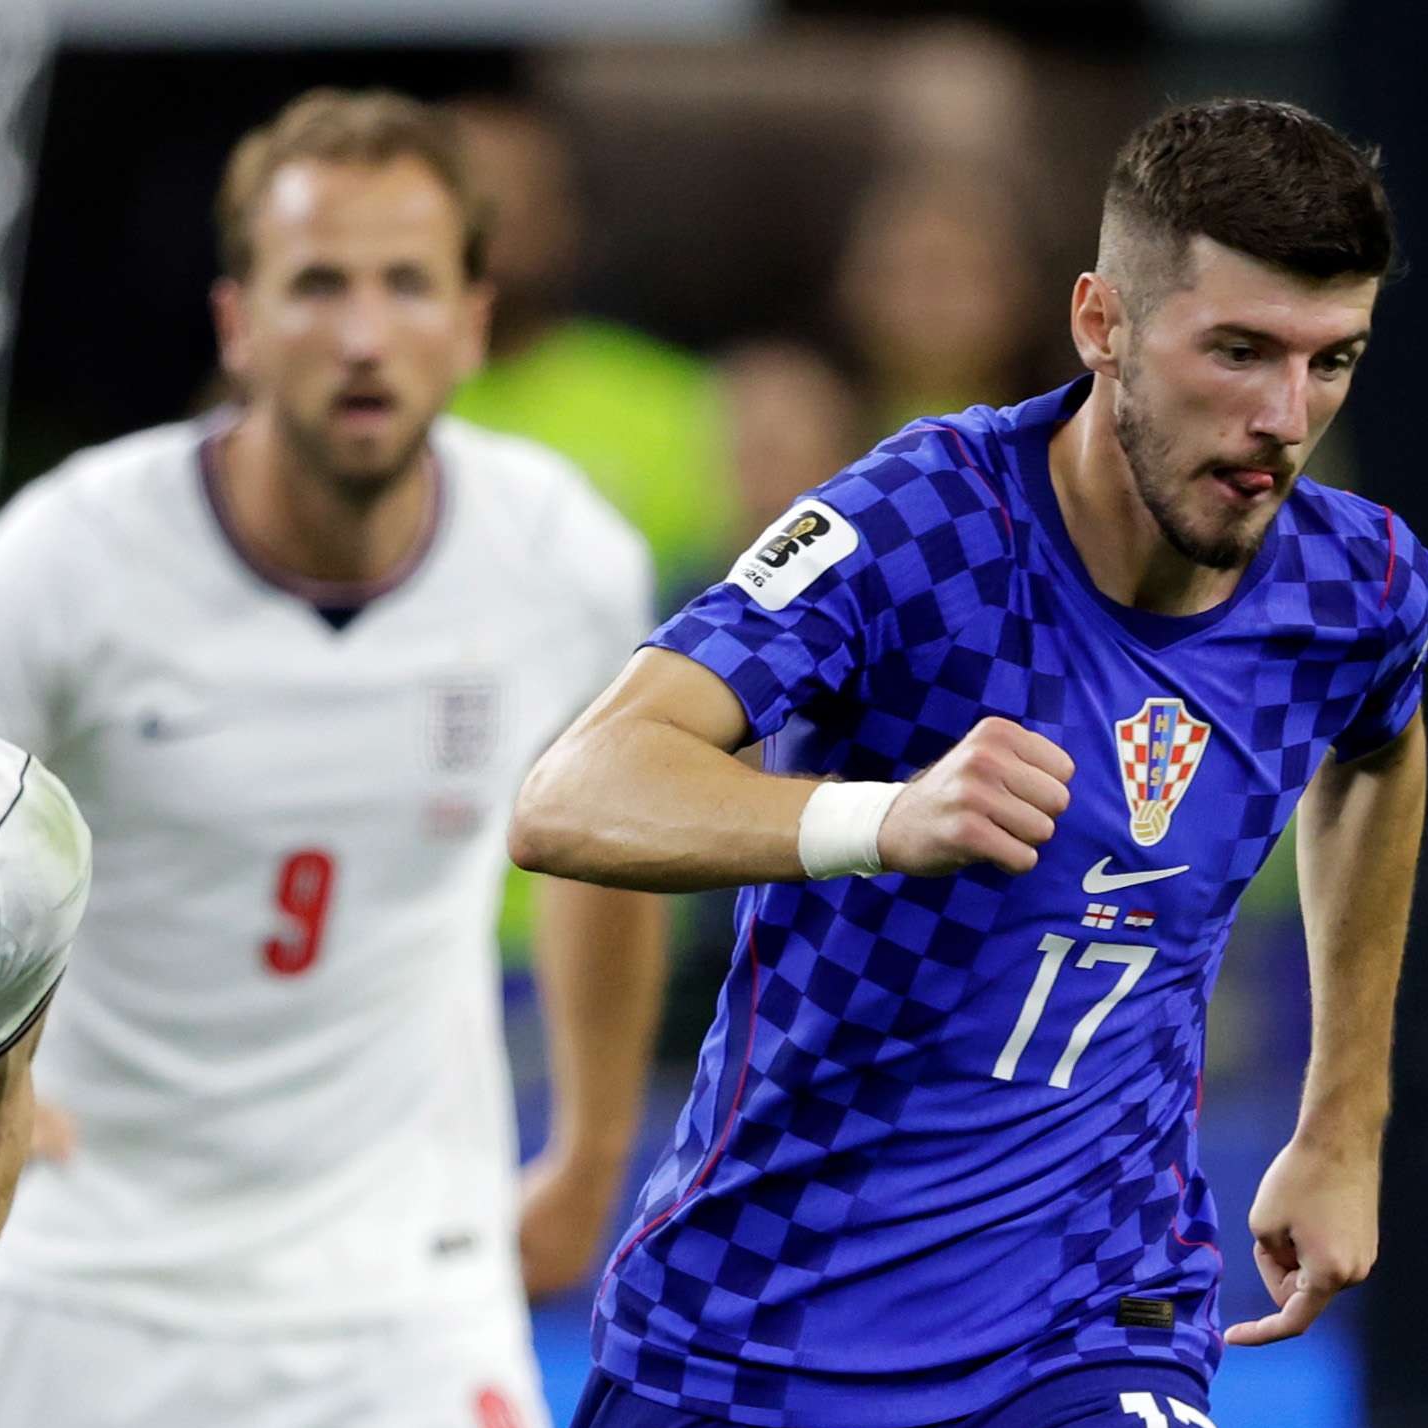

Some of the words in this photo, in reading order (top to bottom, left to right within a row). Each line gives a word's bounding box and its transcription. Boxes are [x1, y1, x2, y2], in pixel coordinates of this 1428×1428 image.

[1149, 713, 1171, 787] HNS
[257, 846, 338, 980] 9
[991, 932, 1159, 1089] 17
